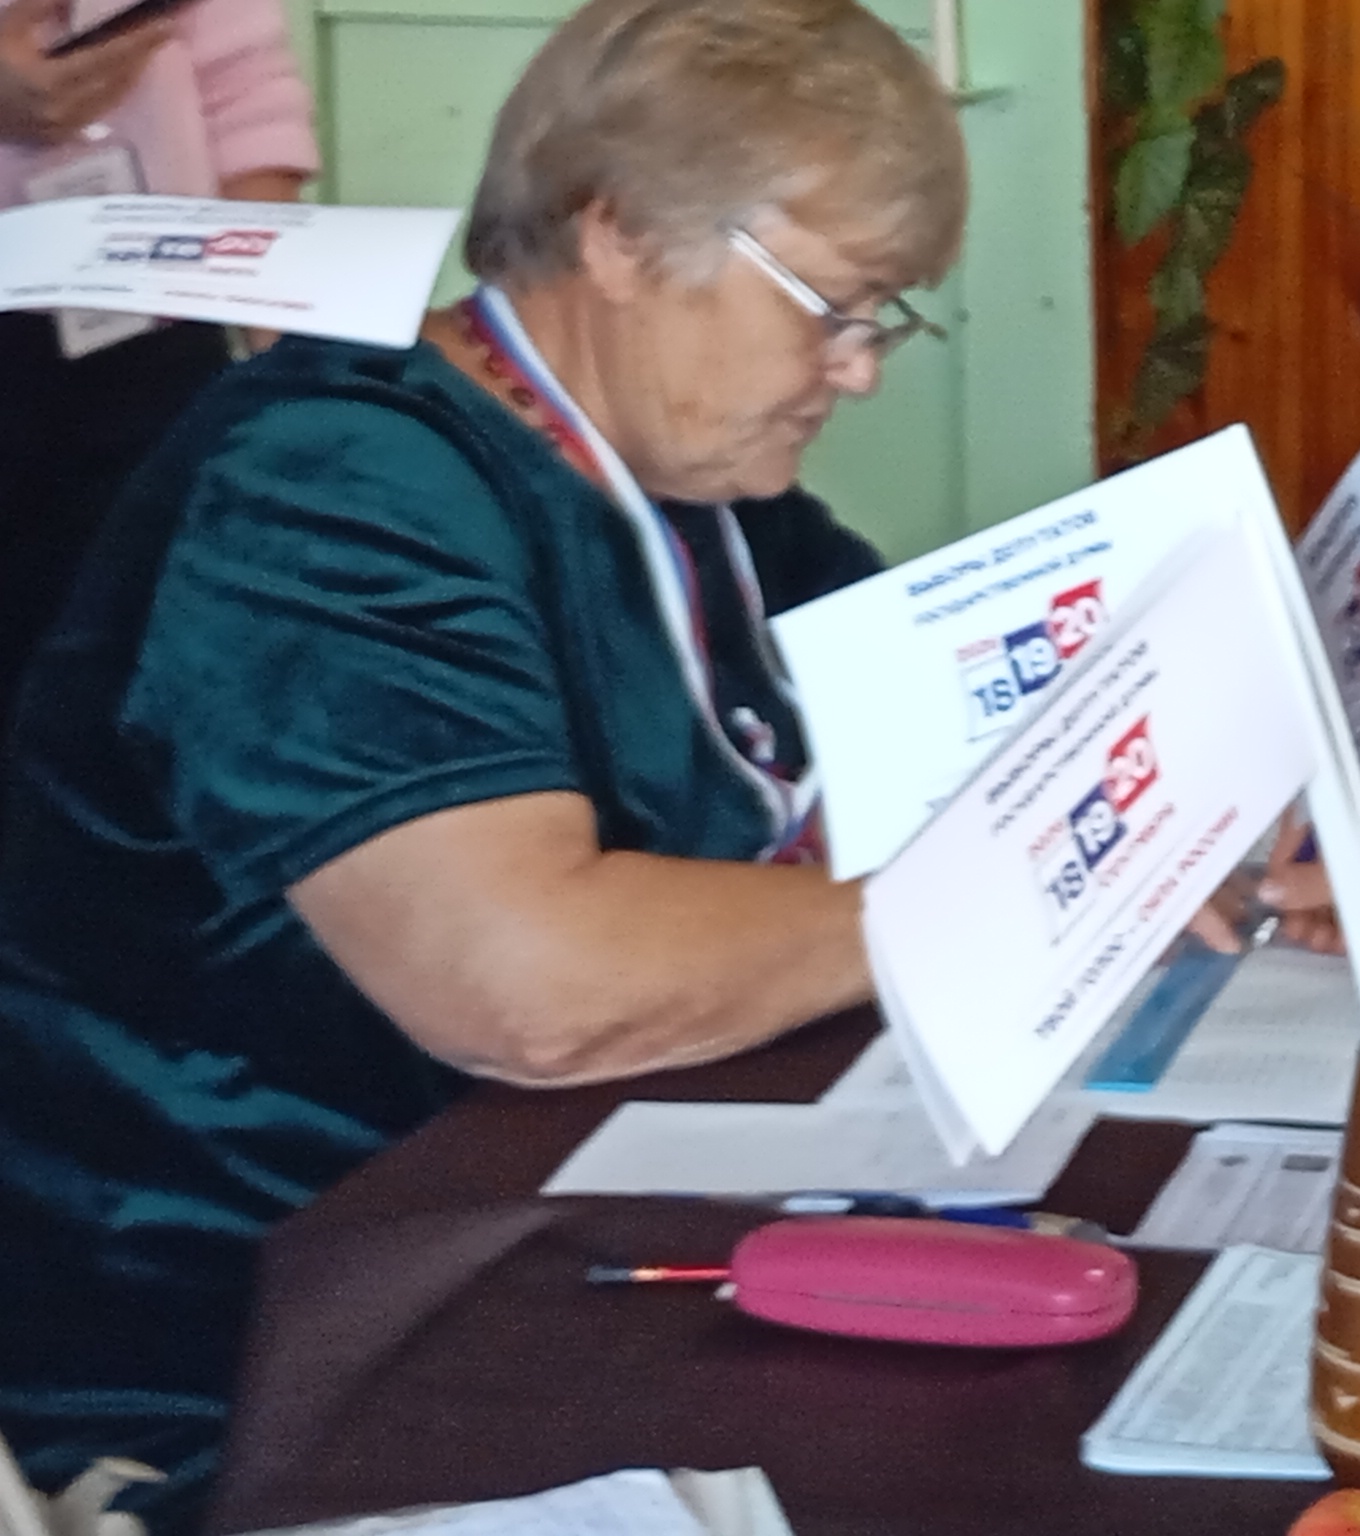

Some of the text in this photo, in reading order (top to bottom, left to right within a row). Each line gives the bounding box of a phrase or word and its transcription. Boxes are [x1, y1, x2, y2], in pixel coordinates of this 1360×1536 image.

[1009, 636, 1059, 682] 19
[1048, 596, 1103, 646] 20
[1073, 801, 1116, 854] 19
[1102, 736, 1153, 801] 20
